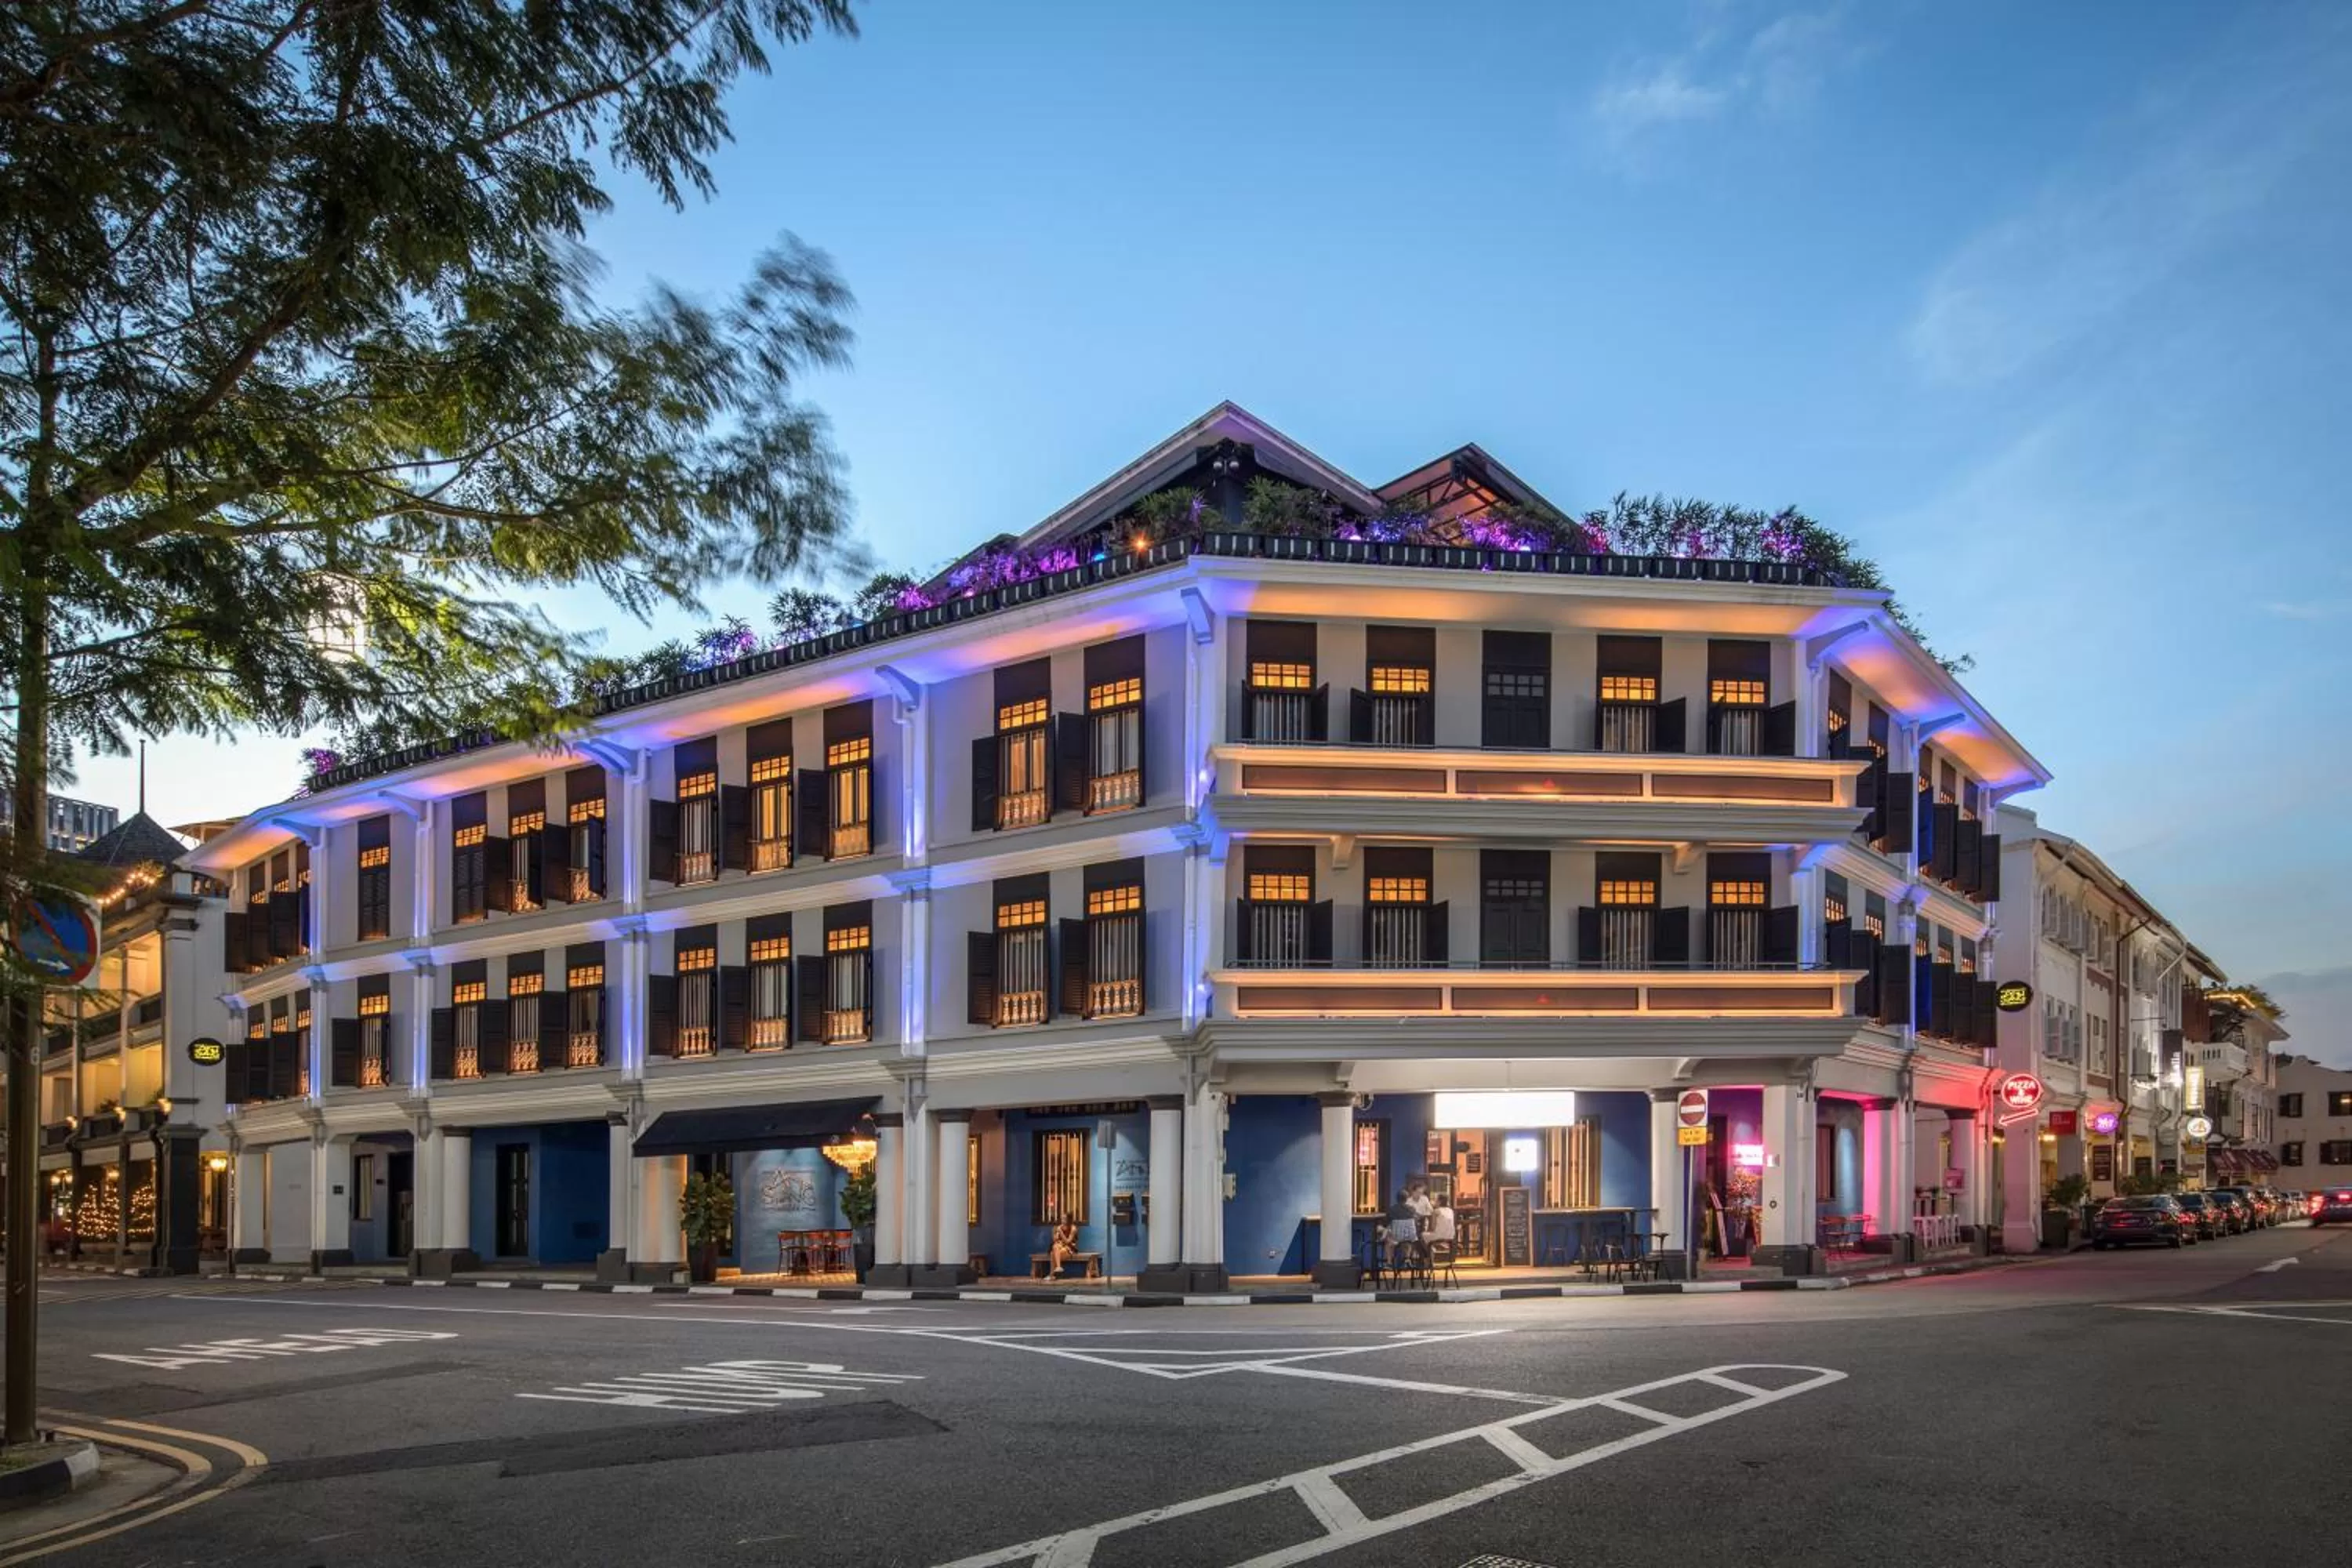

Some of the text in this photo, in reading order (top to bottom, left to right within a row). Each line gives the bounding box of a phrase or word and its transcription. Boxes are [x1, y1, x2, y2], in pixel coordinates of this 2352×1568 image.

[2007, 1081, 2037, 1091] PIZZA
[89, 1328, 459, 1370] AHEAD
[514, 1360, 926, 1413] HUMP
